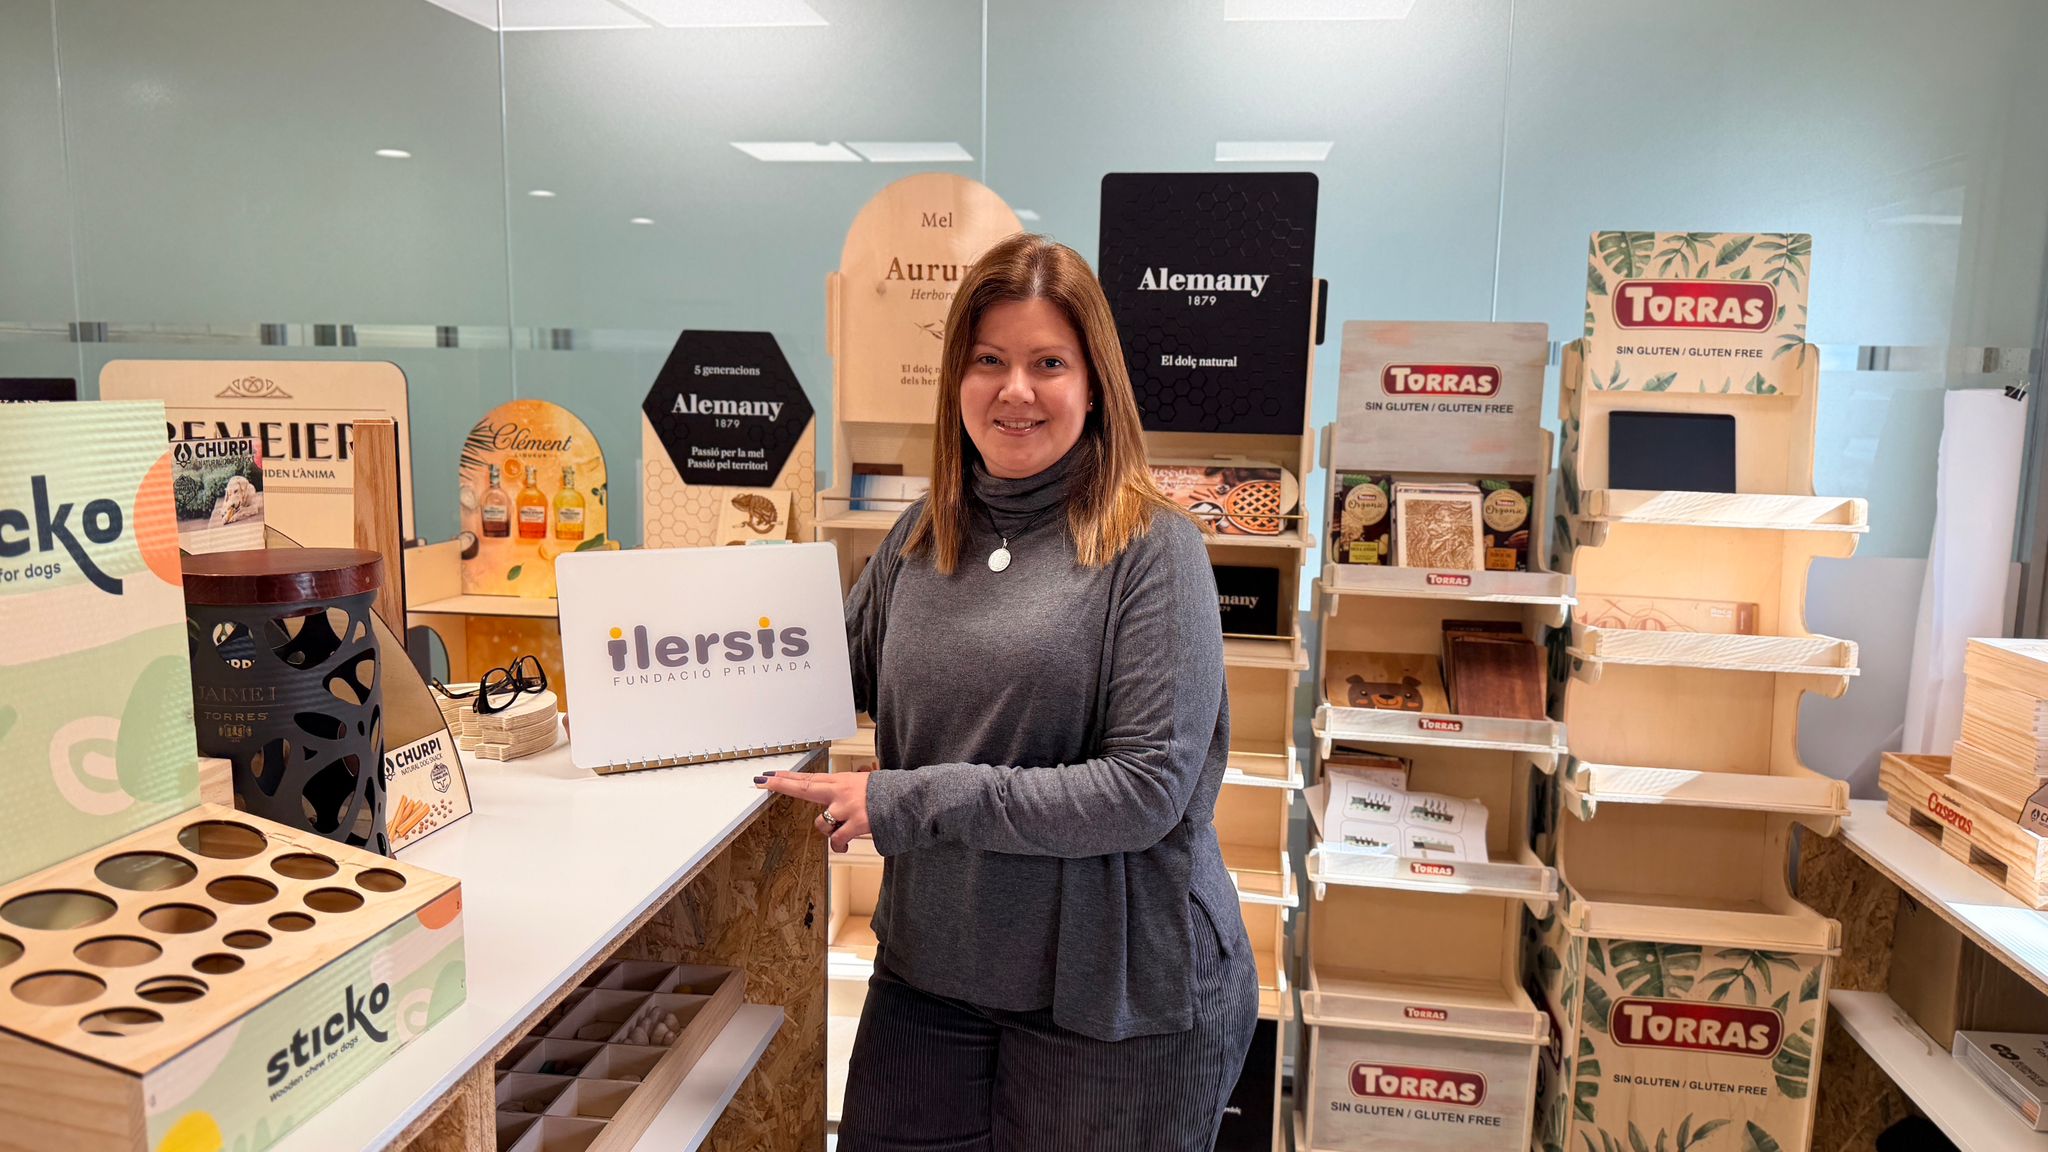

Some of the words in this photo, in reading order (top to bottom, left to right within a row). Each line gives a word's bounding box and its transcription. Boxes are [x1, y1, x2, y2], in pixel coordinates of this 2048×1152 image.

[921, 212, 953, 228] Mel
[1137, 267, 1270, 298] Alemany
[1187, 296, 1217, 306] 1879
[1624, 286, 1765, 325] TORRAS
[1616, 345, 1634, 355] SIN
[1636, 346, 1680, 356] GLUTEN
[1681, 347, 1686, 357] /
[1688, 347, 1732, 358] GLUTEN
[1734, 348, 1764, 358] FREE
[694, 365, 701, 375] 5
[702, 365, 761, 376] generacions
[901, 365, 911, 373] El
[912, 364, 932, 375] dolç
[1160, 355, 1173, 367] El
[1174, 355, 1198, 369] dolç
[1199, 356, 1238, 368] natural
[900, 377, 920, 386] dels
[921, 377, 940, 386] her
[1389, 367, 1494, 394] TORRAS
[671, 392, 785, 422] Alemany
[1365, 401, 1383, 411] SIN
[1385, 402, 1430, 412] GLUTEN
[1431, 402, 1436, 412] /
[1437, 403, 1483, 413] GLUTEN
[1484, 404, 1514, 414] FREE
[715, 419, 741, 429] 1879
[489, 422, 573, 452] Clément
[195, 440, 253, 458] CHURPI
[691, 446, 720, 456] Passió
[721, 448, 736, 459] per
[737, 447, 746, 457] la
[747, 448, 765, 458] mel
[687, 459, 716, 469] Passió
[717, 459, 730, 471] pel
[732, 460, 768, 471] territori
[24, 563, 62, 580] dogs
[1429, 573, 1469, 586] TORRAS
[607, 616, 810, 672] ilersis
[613, 667, 712, 687] FUNDACIÓ
[723, 660, 812, 677] PRIVADA
[200, 687, 264, 701] JAIME
[204, 711, 269, 721] TORRES
[1421, 719, 1461, 732] TORRAS
[395, 737, 442, 768] CHURPI
[401, 763, 421, 776] NATURAL
[420, 760, 430, 768] DOG
[430, 753, 443, 764] SNACK
[1928, 792, 1973, 836] Caseras
[1412, 863, 1452, 876] TORRAS
[1406, 1007, 1446, 1020] TORRAS
[267, 982, 389, 1087] sticko
[1623, 1004, 1770, 1050] TORRAS
[269, 1075, 304, 1102] Wooden
[304, 1059, 326, 1078] chew
[327, 1049, 338, 1063] for
[340, 1036, 359, 1052] dogs
[1358, 1066, 1477, 1103] TORRAS
[1613, 1073, 1632, 1084] SIN
[1634, 1075, 1680, 1089] GLUTEN
[1682, 1079, 1687, 1090] /
[1689, 1080, 1735, 1094] GLUTEN
[1737, 1084, 1768, 1096] FREE
[1330, 1100, 1351, 1113] SIN
[1354, 1103, 1404, 1118] GLUTEN
[1407, 1108, 1411, 1119] /
[1414, 1109, 1465, 1125] GLUTEN
[1468, 1114, 1501, 1127] FREE
